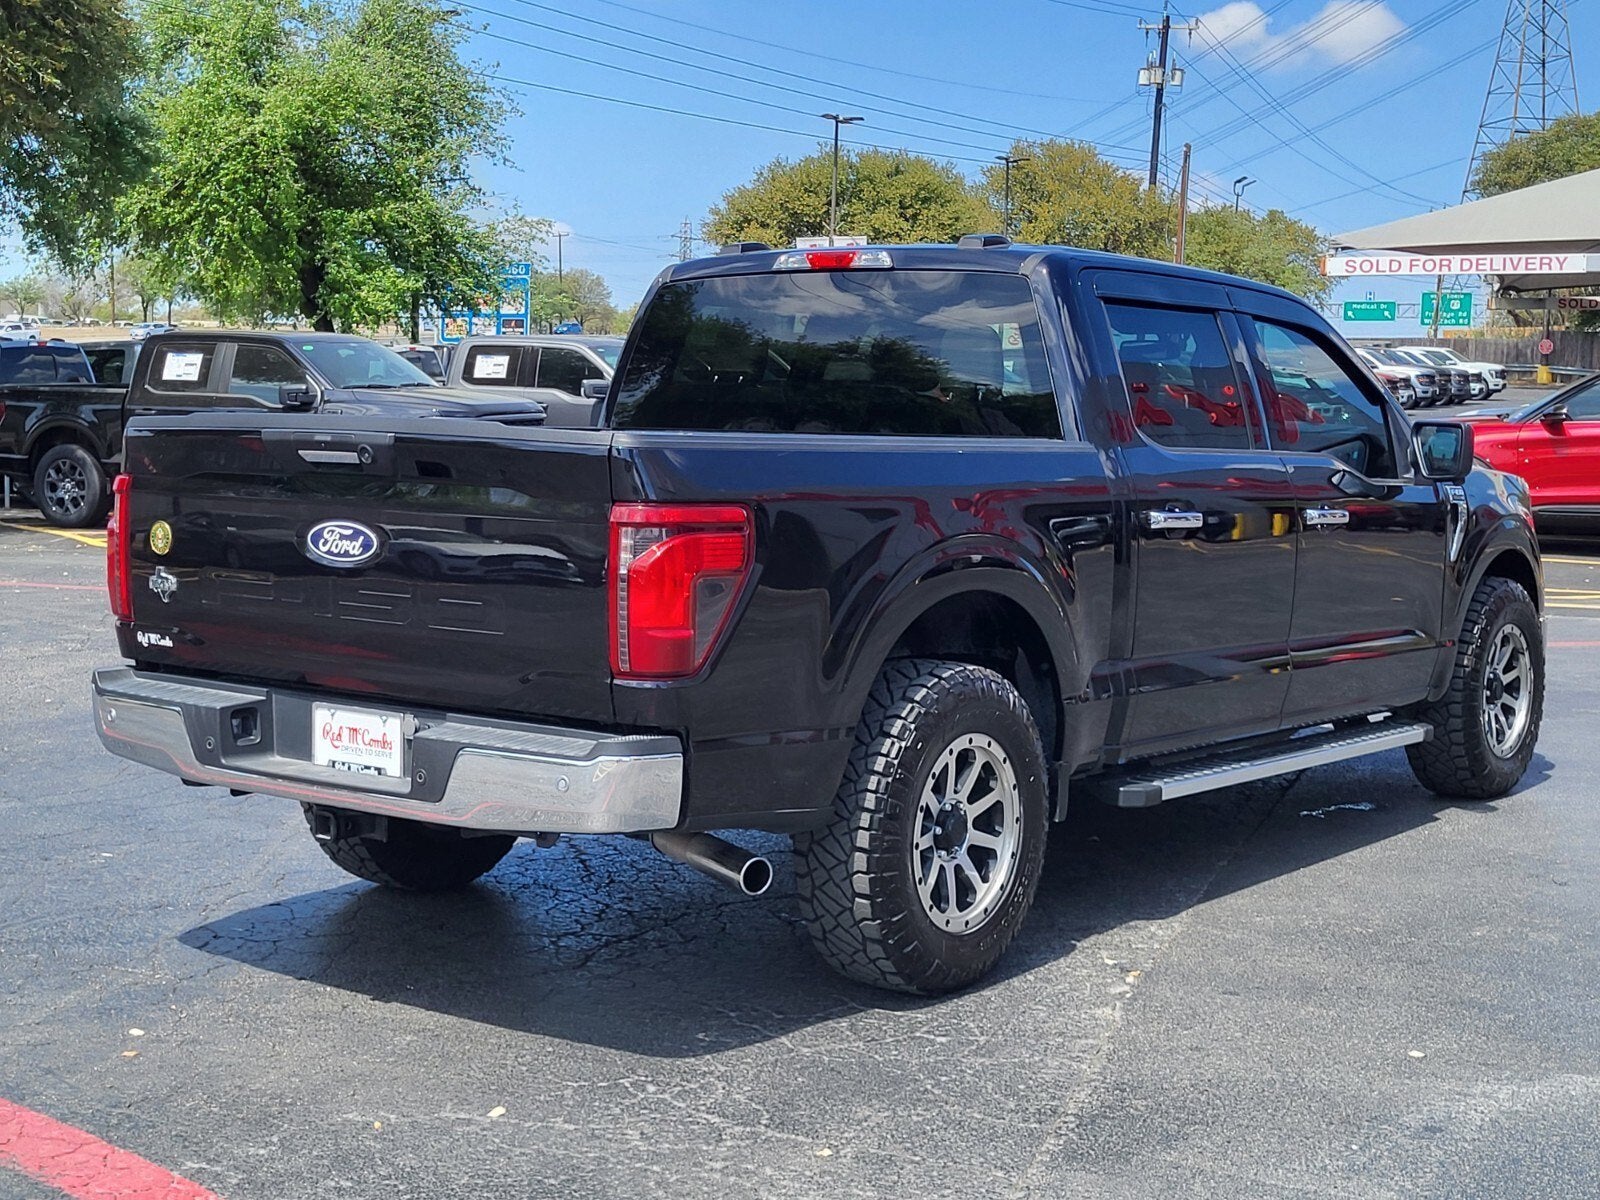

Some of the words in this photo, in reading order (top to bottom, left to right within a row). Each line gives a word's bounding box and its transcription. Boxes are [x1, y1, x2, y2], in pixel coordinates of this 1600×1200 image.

[1344, 258, 1402, 274] SOLD
[1408, 258, 1453, 273] FOR
[1459, 256, 1569, 272] DELIVERY
[1557, 298, 1599, 309] SOLD
[317, 526, 364, 556] Ford
[322, 722, 343, 749] Red
[345, 726, 393, 750] McCombs
[341, 744, 364, 756] DRIVEN
[365, 748, 373, 757] TO
[374, 749, 393, 759] SERVE
